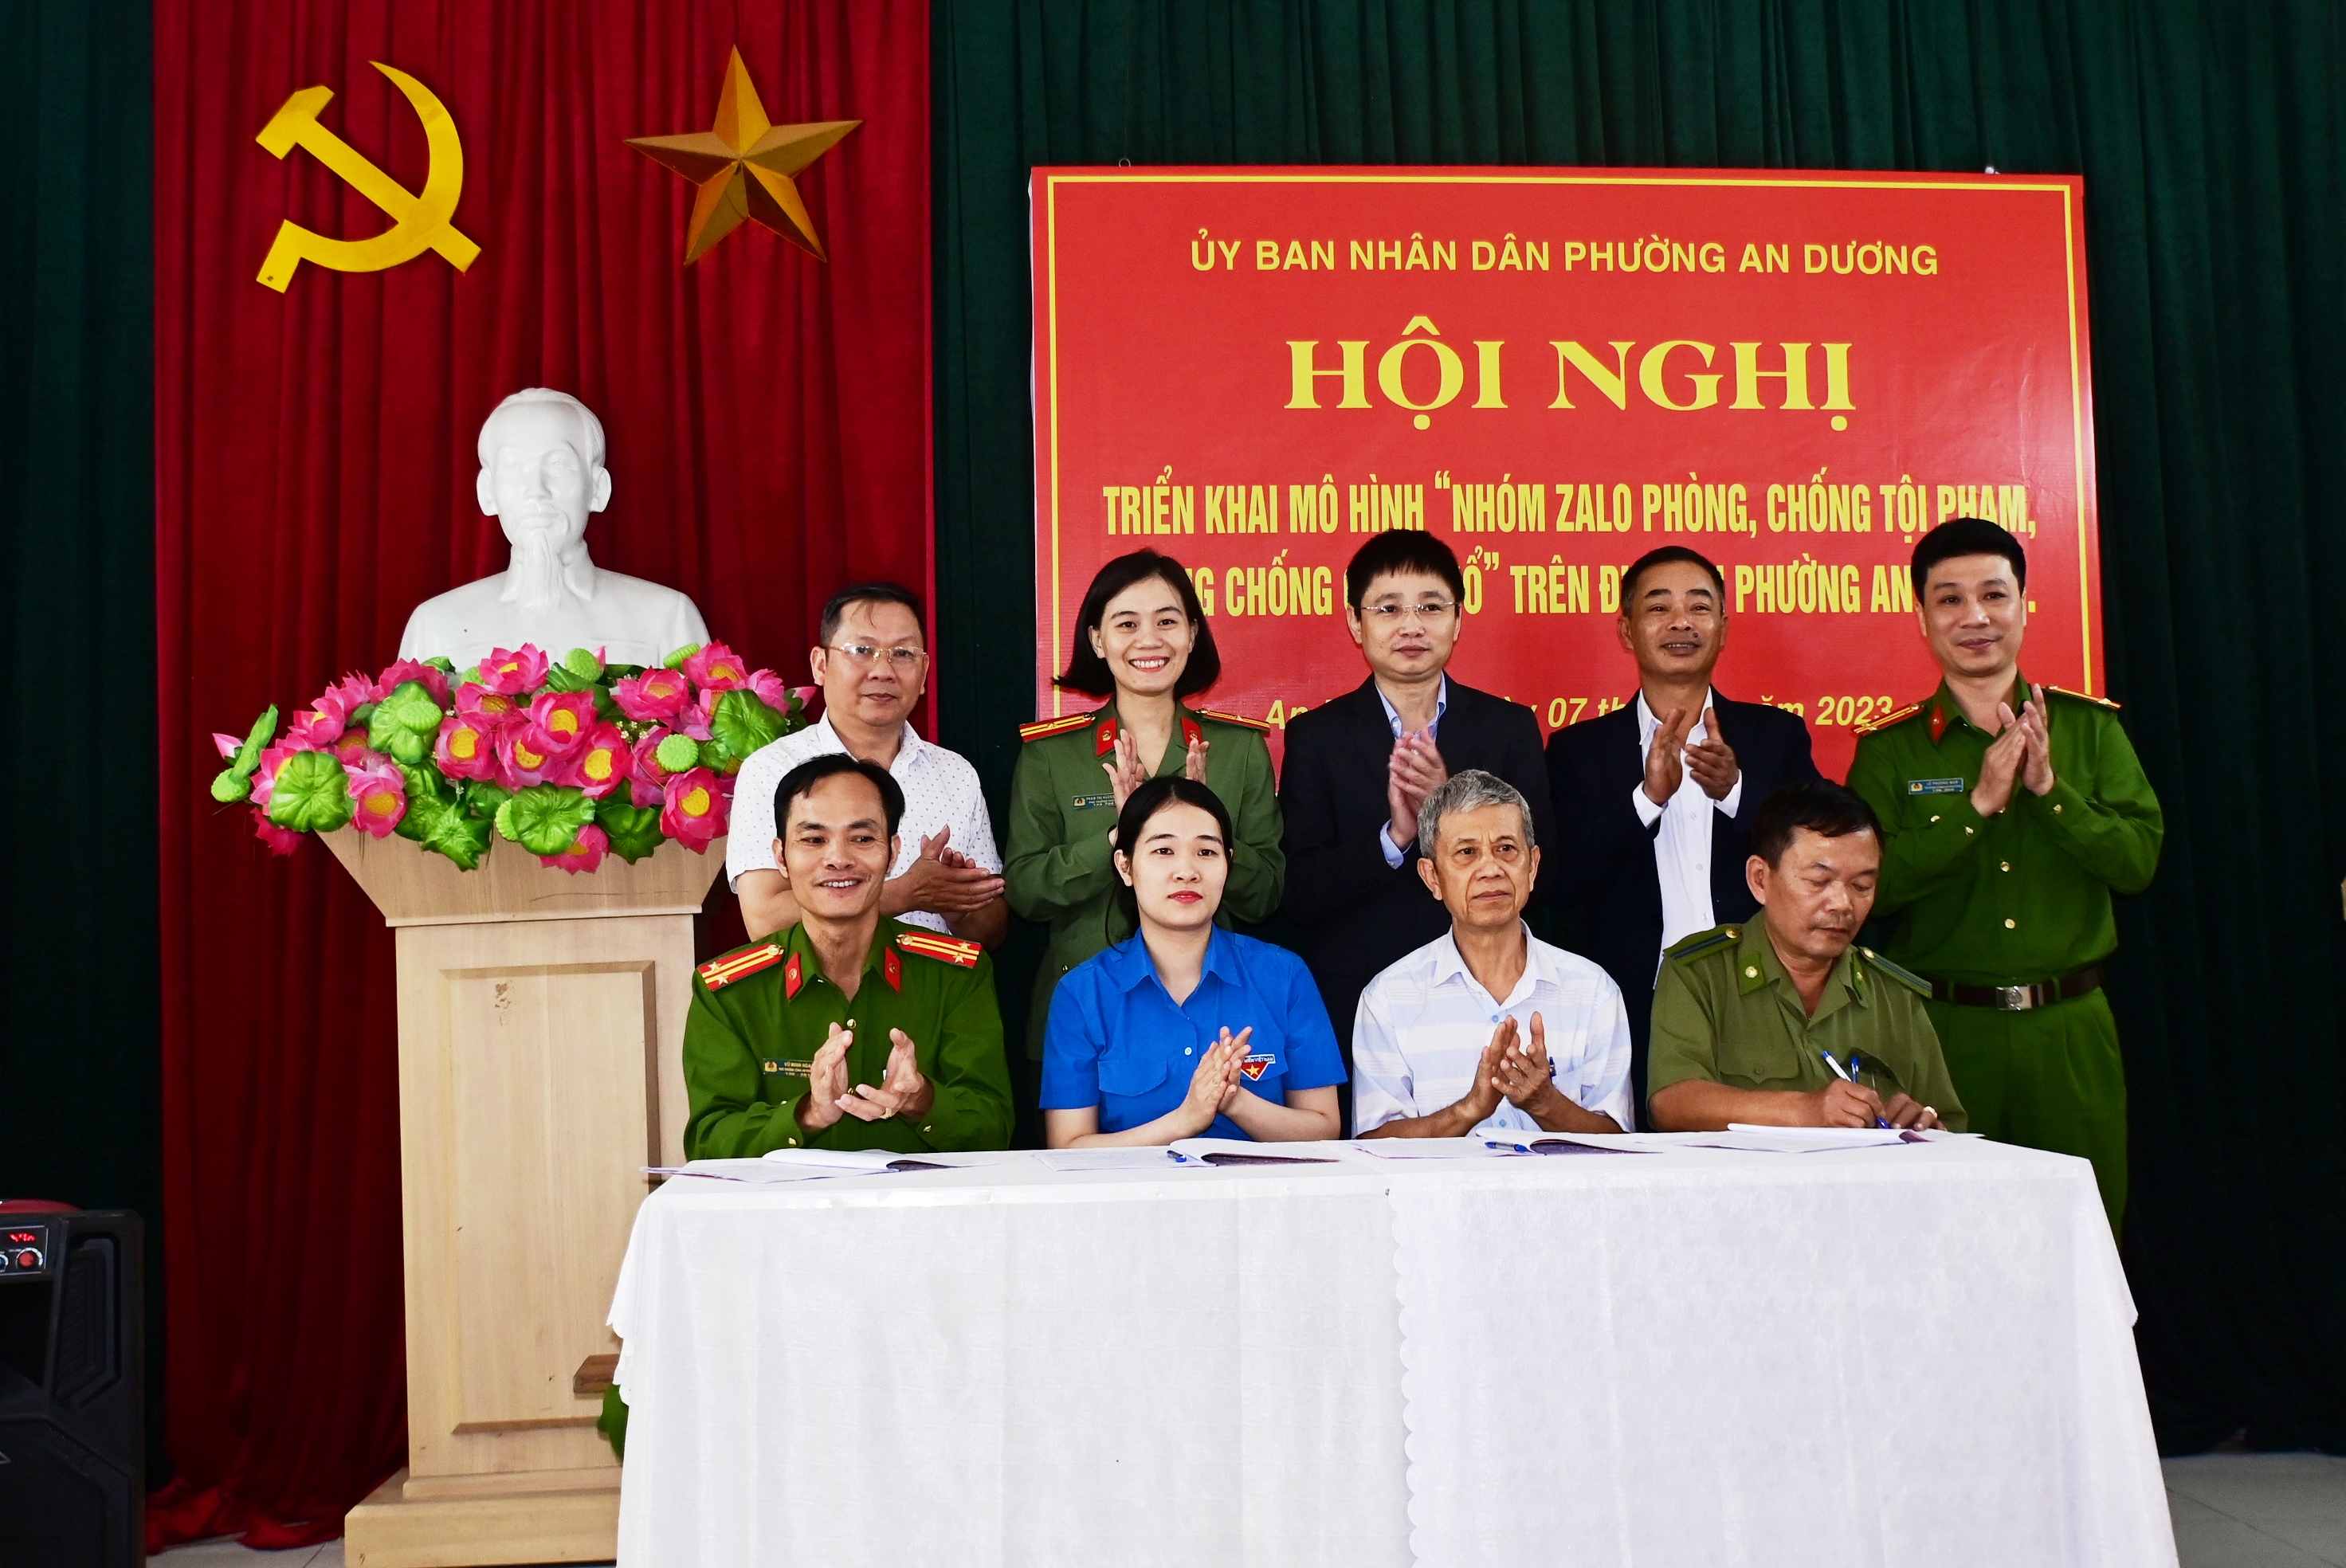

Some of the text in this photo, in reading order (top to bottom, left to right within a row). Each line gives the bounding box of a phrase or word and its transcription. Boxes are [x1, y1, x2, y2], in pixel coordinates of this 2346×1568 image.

[1191, 229, 1938, 276] ỦY BAN NHÂN DÂN PHƯỜNG AN DƯƠNG
[1285, 316, 1857, 431] HỘI NGHỊ
[1103, 465, 1195, 535] TRIỂN
[1205, 484, 1278, 535] KHAI
[1289, 474, 1339, 535] MÔ
[1349, 473, 1425, 533] HÌNH
[1556, 483, 1633, 533] ZALO
[1643, 472, 1757, 538] PHÒNG,
[1767, 466, 1872, 533] CHỐNG
[1880, 473, 1928, 543] TỘI
[1226, 549, 1333, 617] CHỐNG
[1510, 554, 1591, 613] TRÊN
[1736, 553, 1861, 614] PHƯỜNG
[1871, 565, 1914, 613] AN
[1548, 697, 1588, 728] 07
[1814, 696, 1893, 726] 2023
